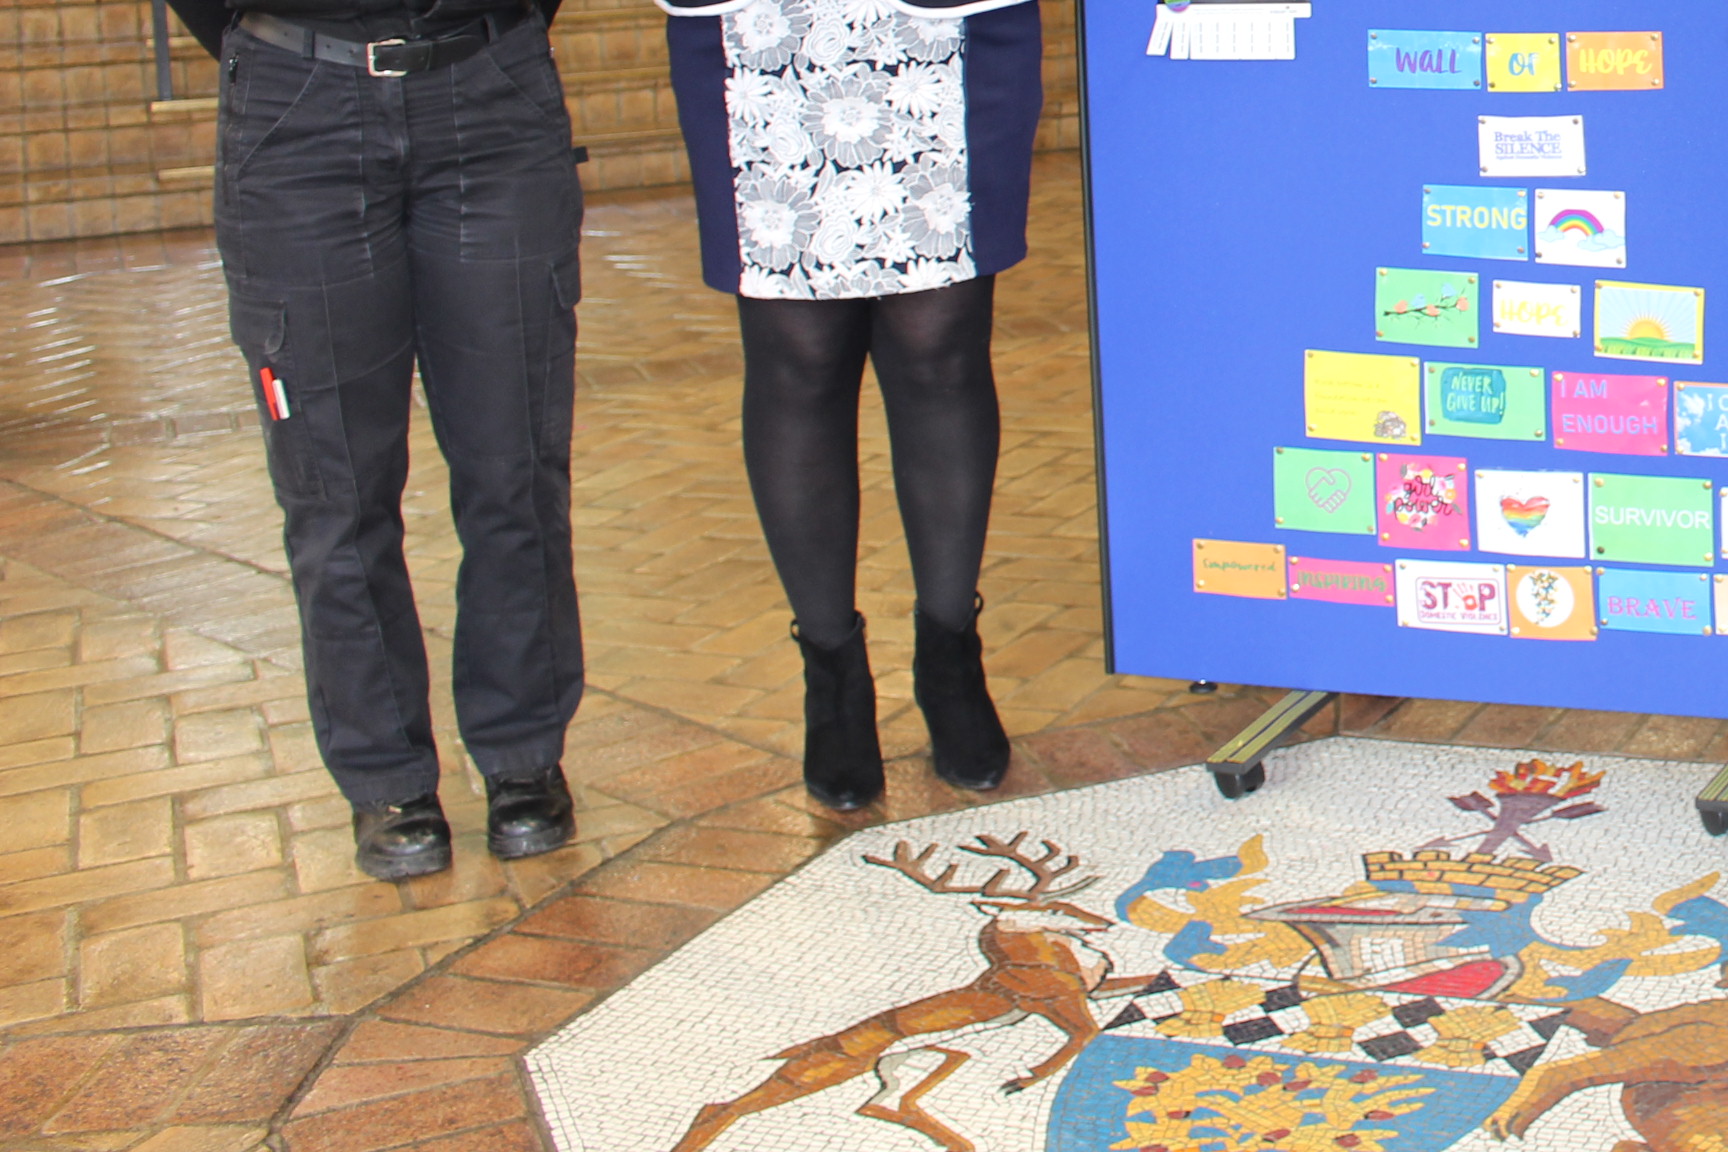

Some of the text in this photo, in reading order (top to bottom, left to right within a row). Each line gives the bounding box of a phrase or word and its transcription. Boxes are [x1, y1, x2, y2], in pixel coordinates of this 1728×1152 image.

[1578, 49, 1652, 75] HOPE
[1494, 129, 1561, 142] Break The
[1495, 142, 1562, 155] SILENCE
[1426, 204, 1527, 230] STRONG
[1500, 299, 1569, 327] HOPE
[1451, 372, 1492, 395] NEVER
[1560, 379, 1608, 398] I AM
[1446, 394, 1505, 416] GIVE UP!
[1706, 394, 1713, 410] I
[1562, 414, 1658, 436] ENOUGH
[1720, 433, 1728, 449] I
[1393, 494, 1458, 521] power
[1594, 506, 1711, 530] SURVIVOR
[1419, 580, 1497, 613] STOP
[1420, 610, 1499, 621] DOMESTIC VIOLENCE
[1607, 596, 1697, 620] BRAVE
